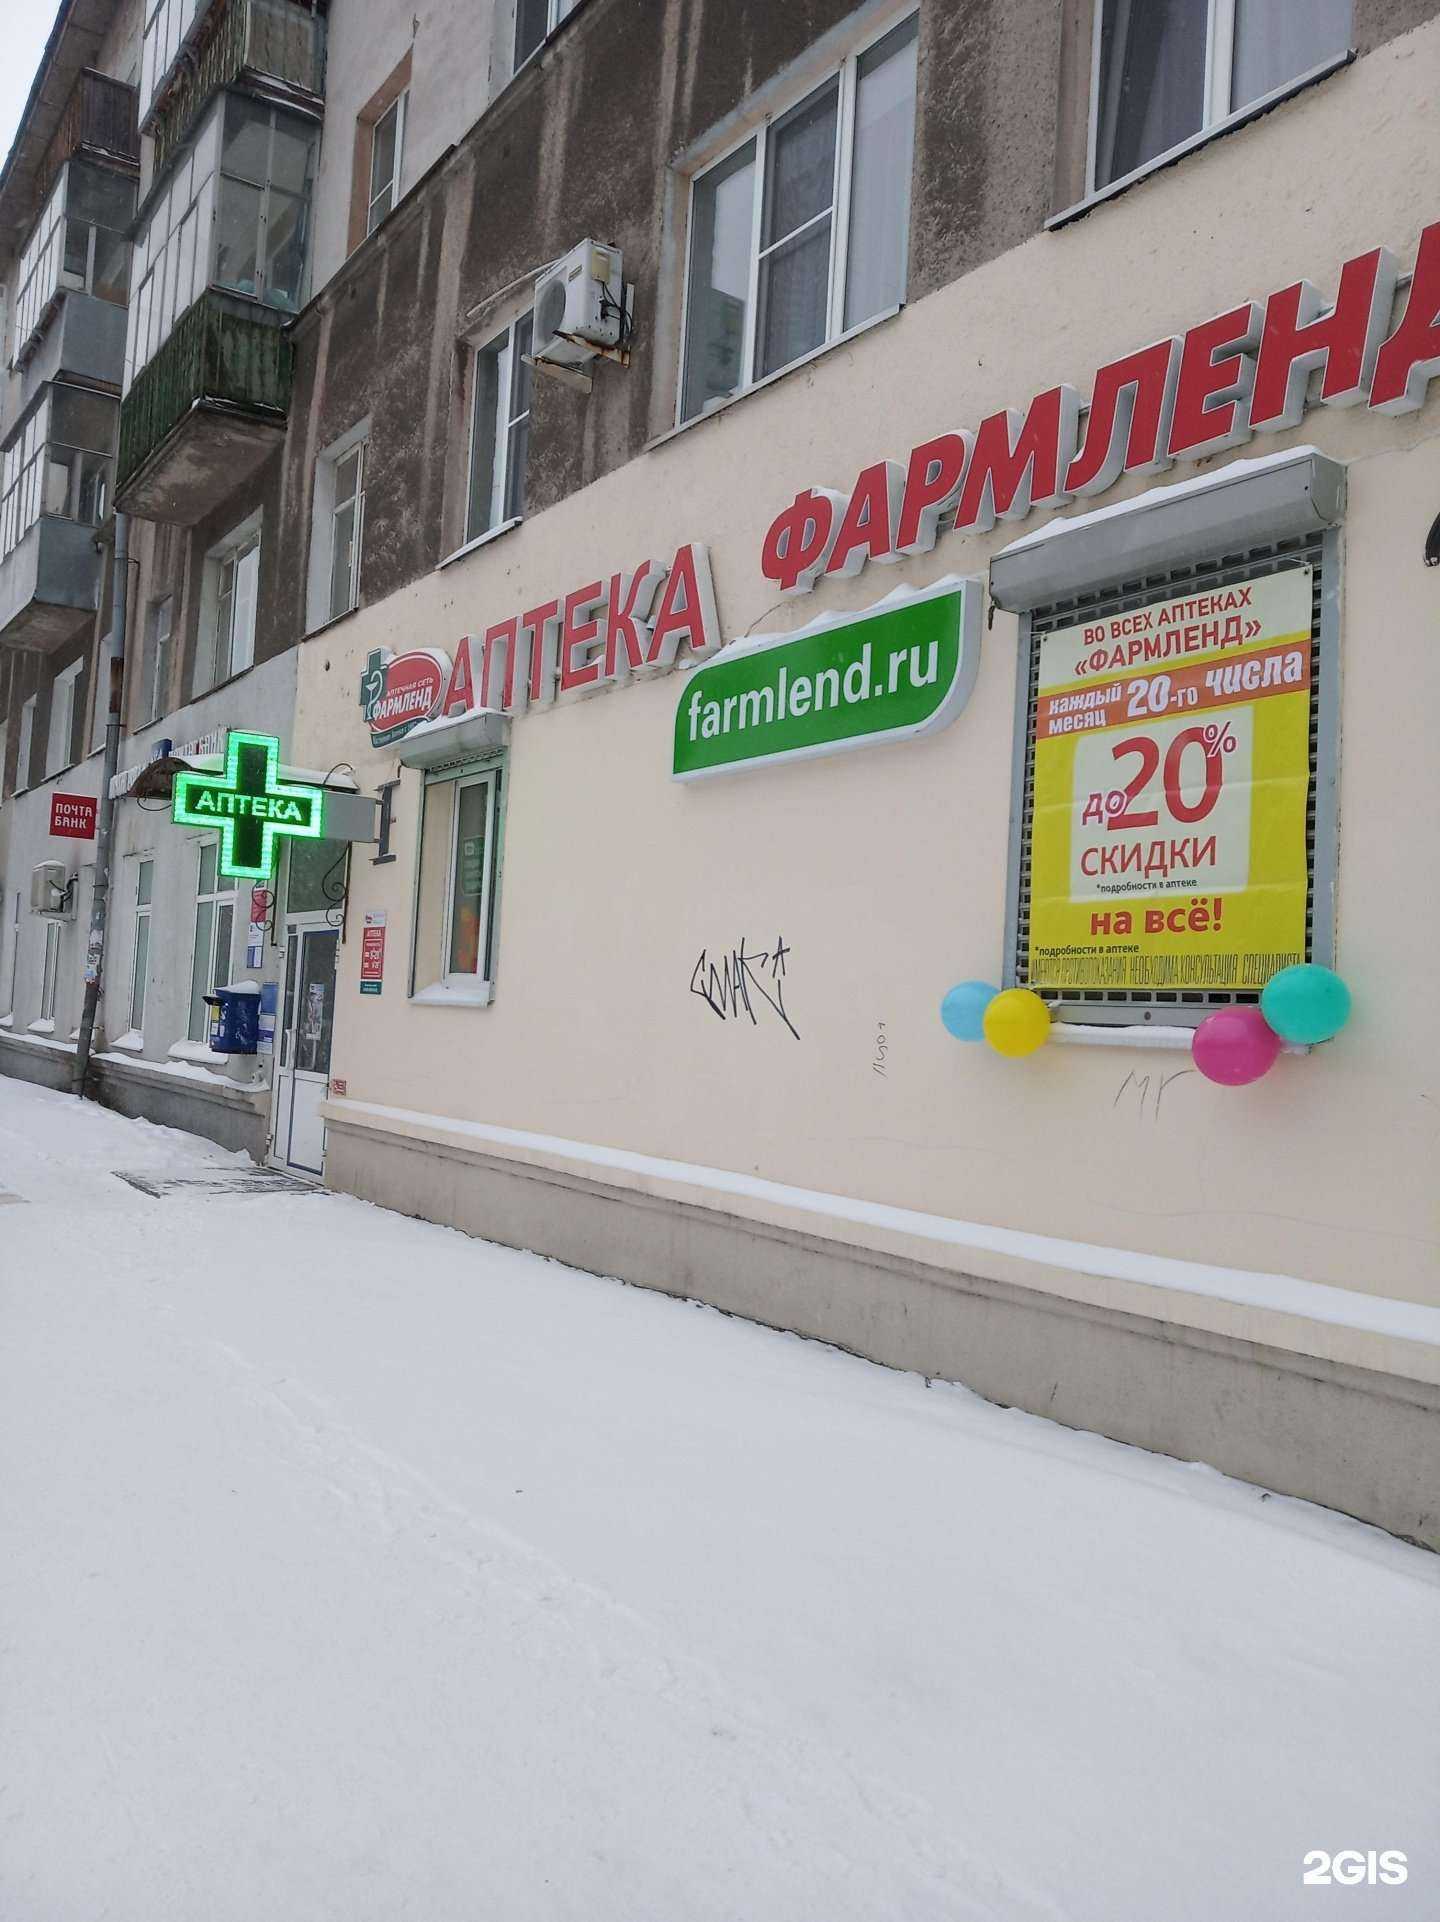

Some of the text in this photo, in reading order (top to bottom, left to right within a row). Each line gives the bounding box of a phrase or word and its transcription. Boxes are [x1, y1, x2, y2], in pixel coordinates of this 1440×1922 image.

[443, 543, 707, 716] АПТЕКА
[1083, 587, 1252, 646] ВО ВСЕХ АПТЕКАХ
[1074, 615, 1263, 676] «ФАРМЛЕНД»
[688, 641, 939, 742] farmlend.ru
[1048, 682, 1122, 716] каждый
[1126, 650, 1304, 718] 20-го числа
[372, 686, 433, 720] ФАРМЛЕНД
[1048, 709, 1107, 735] месяц
[54, 815, 87, 829] БАНК
[55, 803, 92, 817] ПОЧТА
[194, 790, 302, 822] АПТЕКА
[1166, 879, 1198, 889] аптеке
[1090, 897, 1223, 935] на всё!
[1106, 944, 1140, 954] аптеке
